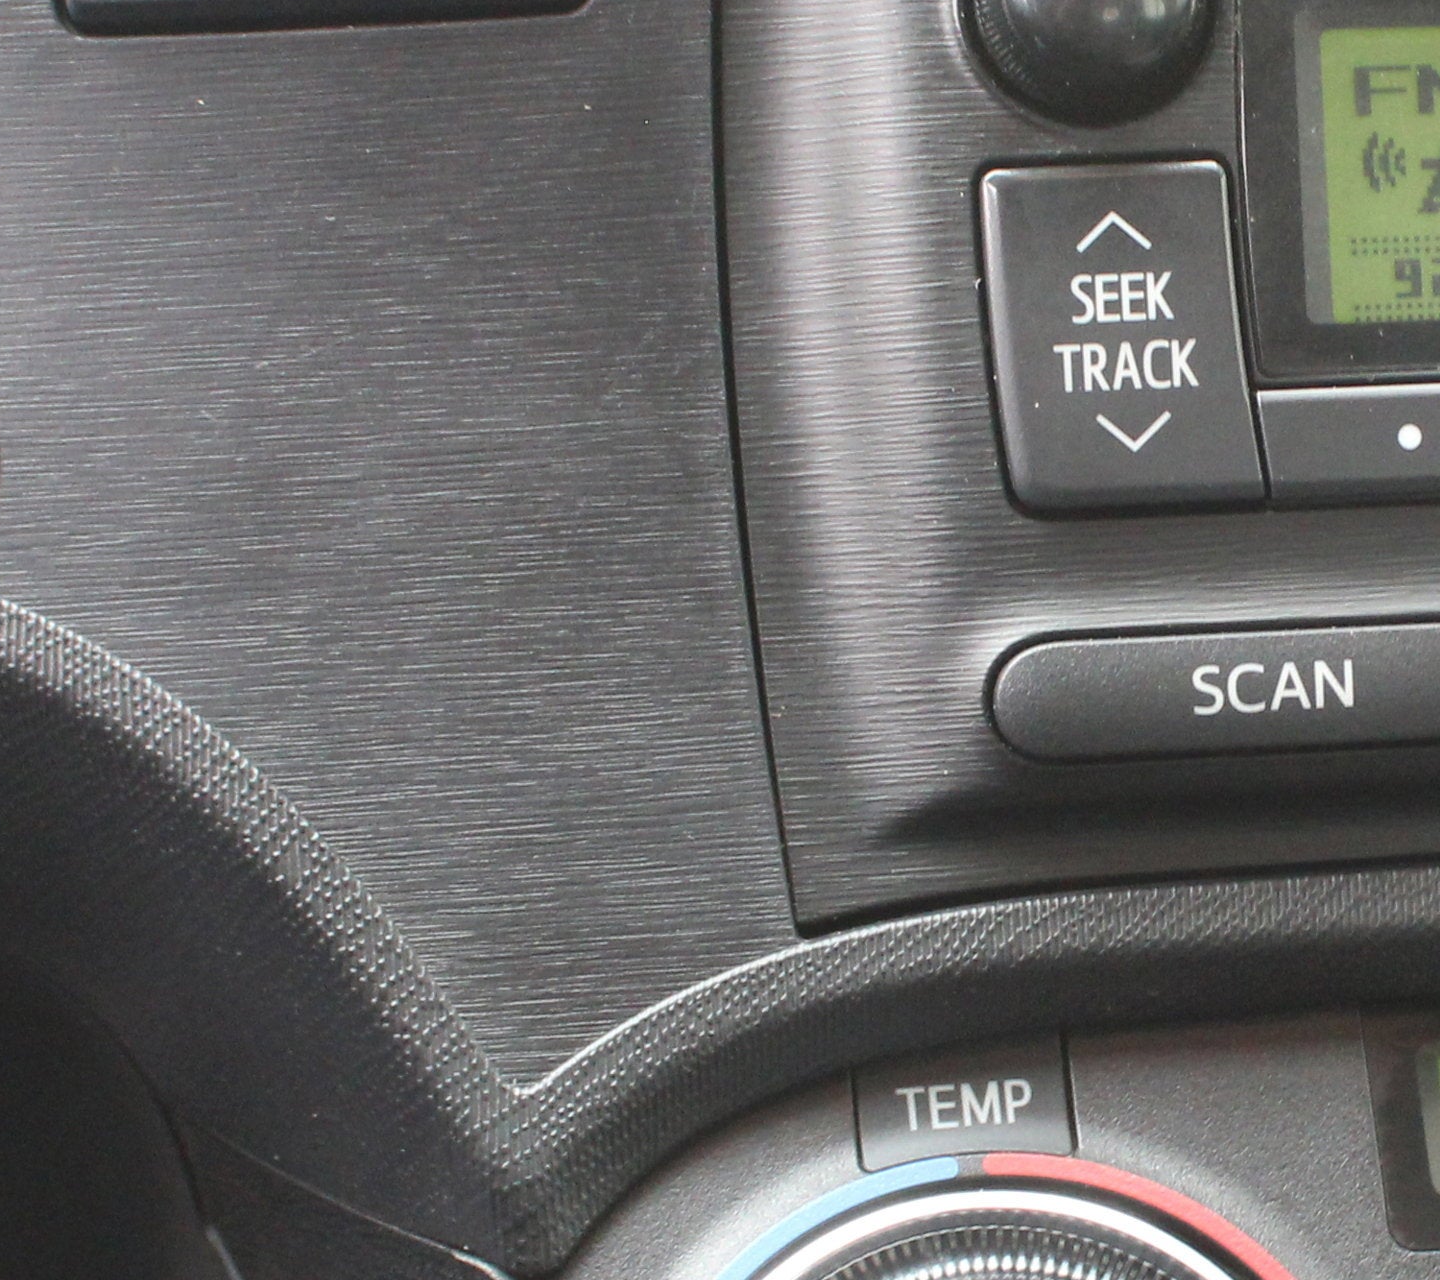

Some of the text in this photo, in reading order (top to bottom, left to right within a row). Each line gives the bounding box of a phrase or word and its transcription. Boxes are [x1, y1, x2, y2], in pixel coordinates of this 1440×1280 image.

[1069, 271, 1175, 326] SEEK
[1052, 337, 1200, 394] TRACK
[1191, 658, 1357, 718] SCAN
[894, 1077, 1034, 1133] TEMP
